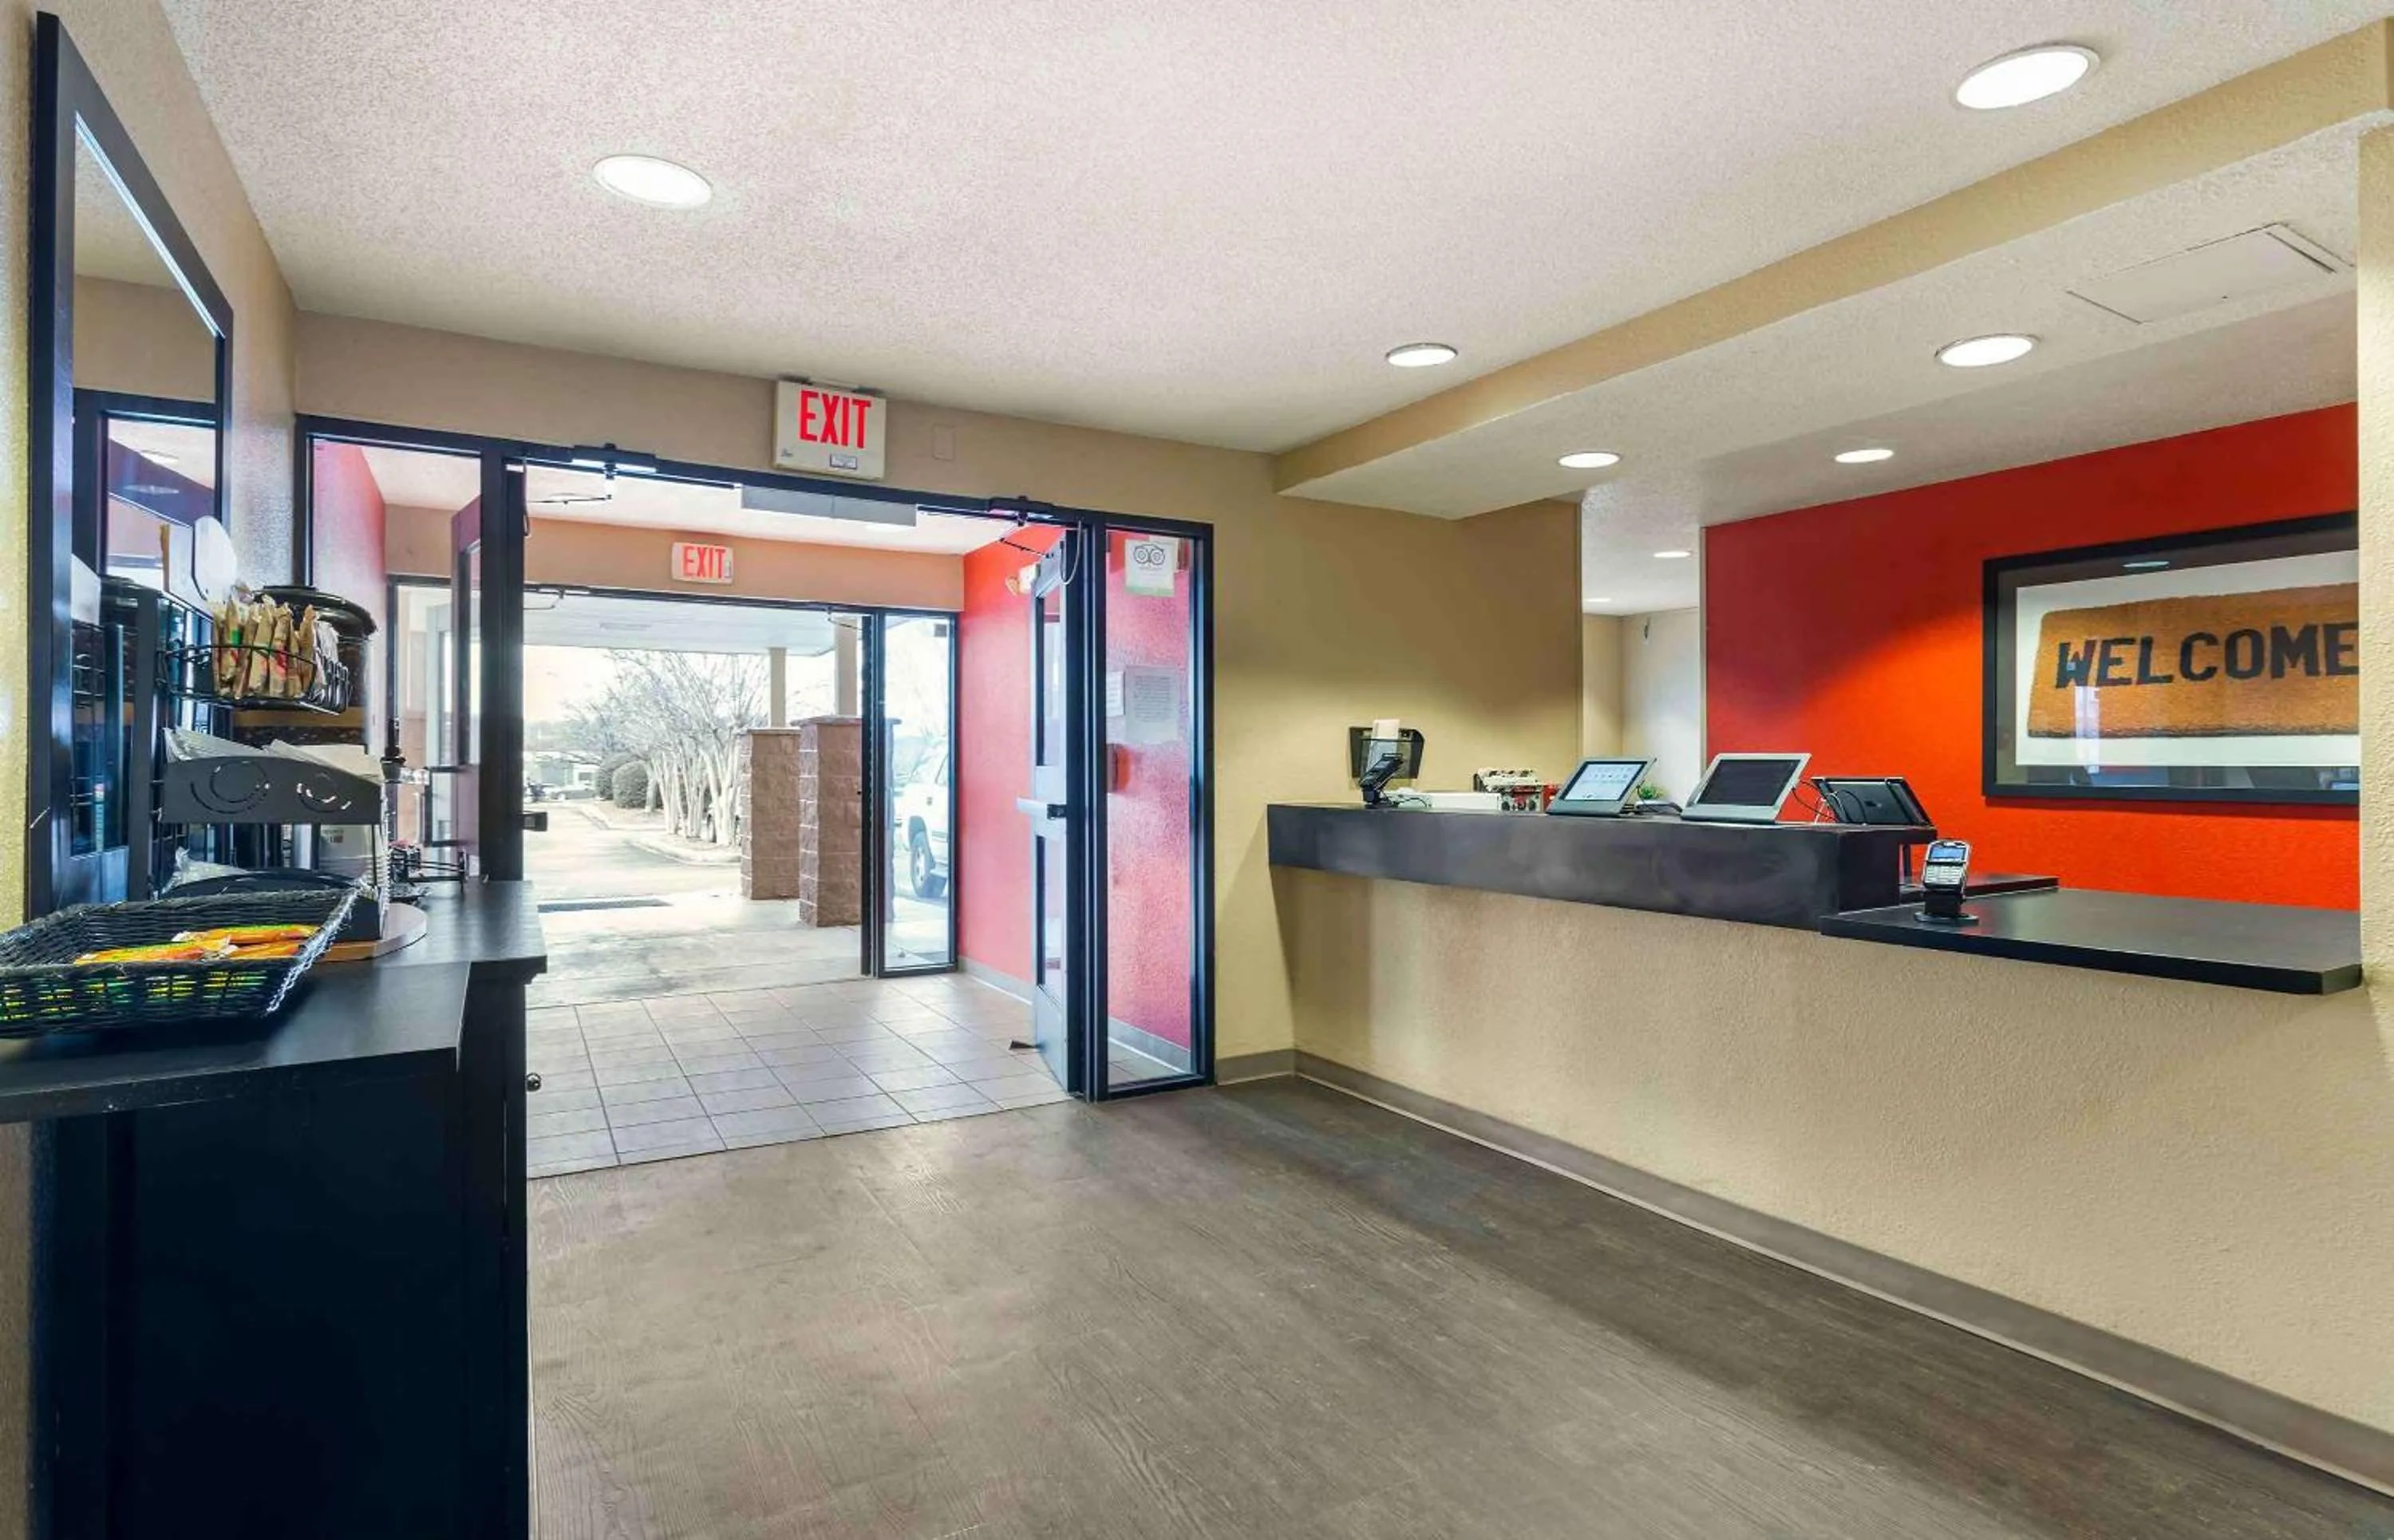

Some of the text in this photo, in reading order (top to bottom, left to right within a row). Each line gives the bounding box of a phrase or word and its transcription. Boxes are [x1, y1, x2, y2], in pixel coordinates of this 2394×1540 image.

[800, 389, 871, 449] EXIT
[683, 545, 726, 578] EXIT
[2055, 622, 2359, 689] WELCOME
